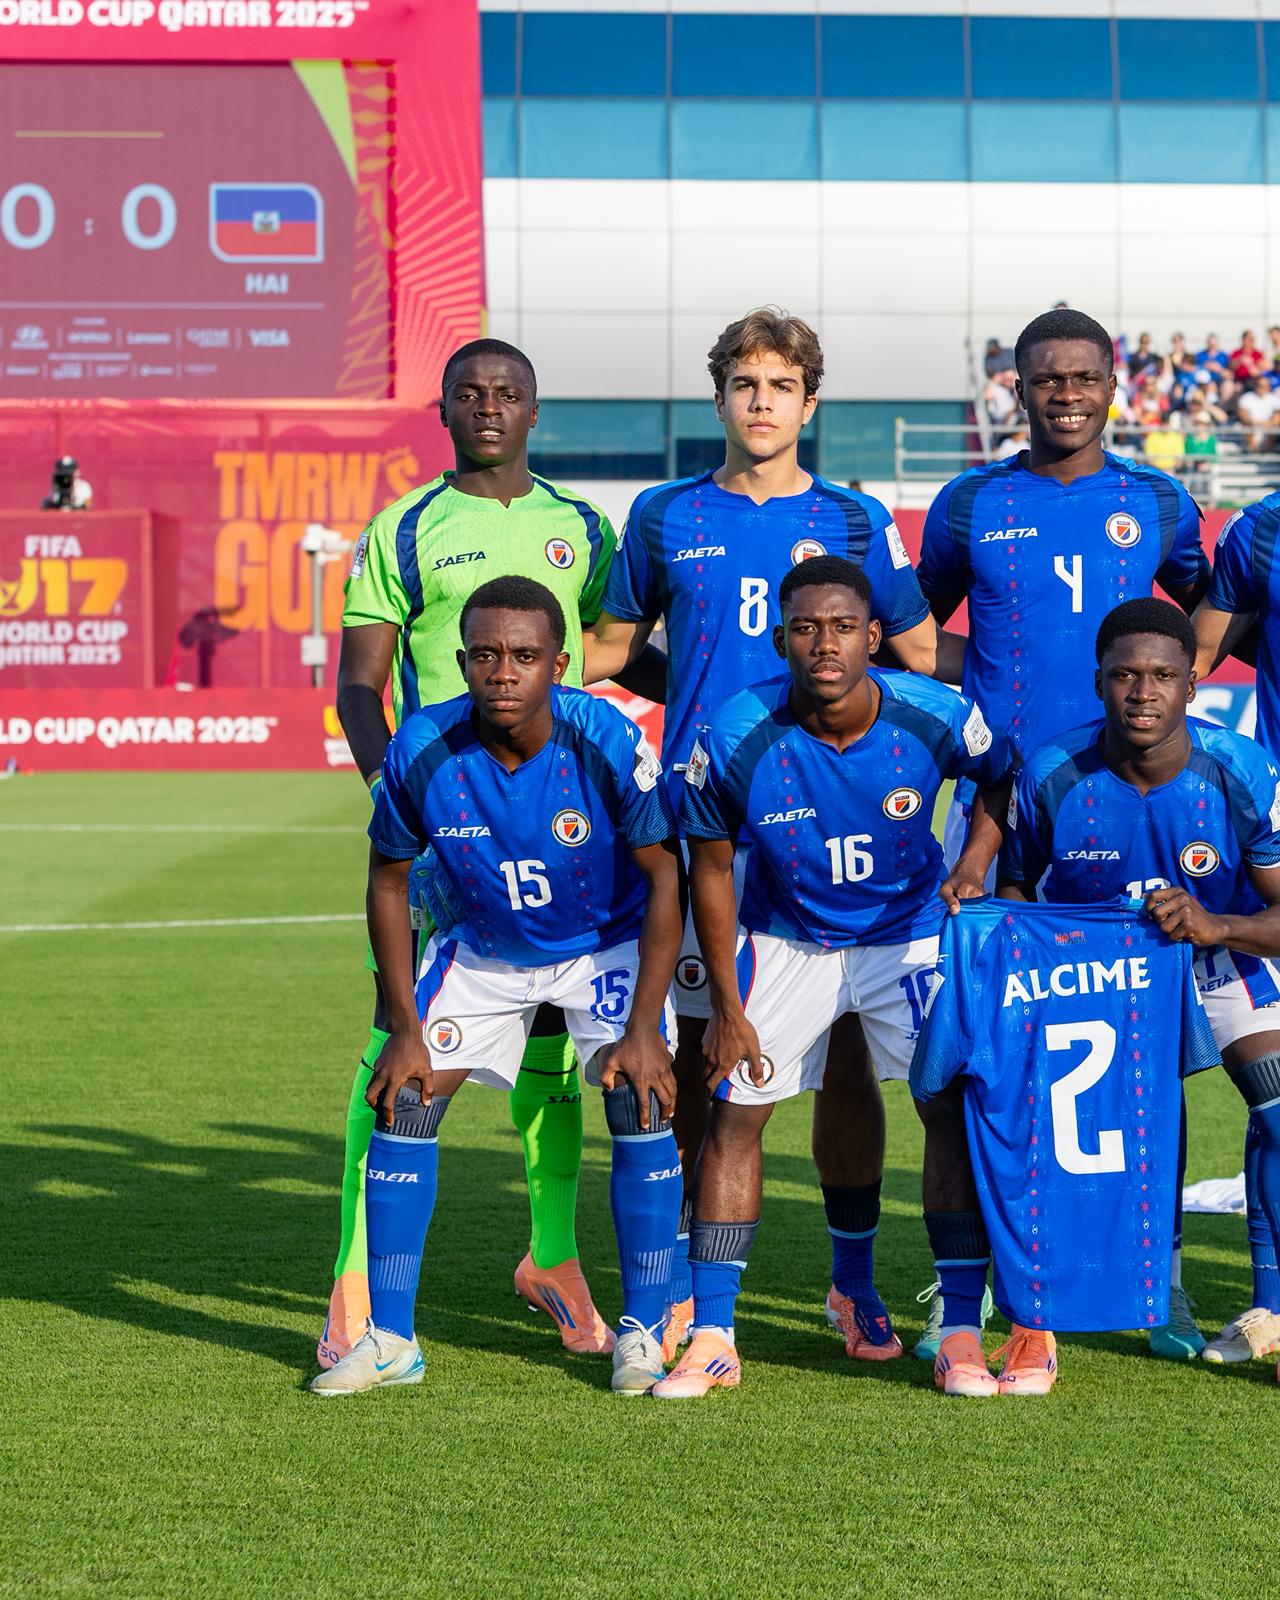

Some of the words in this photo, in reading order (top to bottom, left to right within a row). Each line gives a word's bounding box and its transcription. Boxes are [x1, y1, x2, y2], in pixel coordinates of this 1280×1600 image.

[87, 1, 155, 27] CUP
[159, 1, 271, 32] QATAR
[0, 183, 55, 249] 0
[121, 183, 177, 249] 0
[246, 274, 288, 294] HAI
[980, 526, 1038, 543] SAETA
[25, 535, 83, 558] FIFA
[672, 545, 726, 562] SAETA
[432, 550, 487, 572] SAETA
[1054, 554, 1083, 613] 4
[739, 576, 769, 637] 8
[0, 620, 73, 643] ORLD
[76, 620, 128, 643] CUP
[66, 643, 122, 665] 2025
[34, 717, 95, 744] CUP
[97, 717, 195, 748] QATAR
[757, 807, 817, 825] SAETA
[433, 825, 491, 838] SAETA
[825, 833, 874, 885] 16
[1062, 850, 1121, 861] SAETA
[500, 859, 552, 911] 15
[1055, 930, 1086, 945] HAITI
[590, 969, 630, 1018] 15
[1003, 956, 1151, 1008] ALCIME
[1199, 974, 1233, 992] AETA
[1045, 1020, 1126, 1175] 2
[366, 1168, 418, 1183] SAETA
